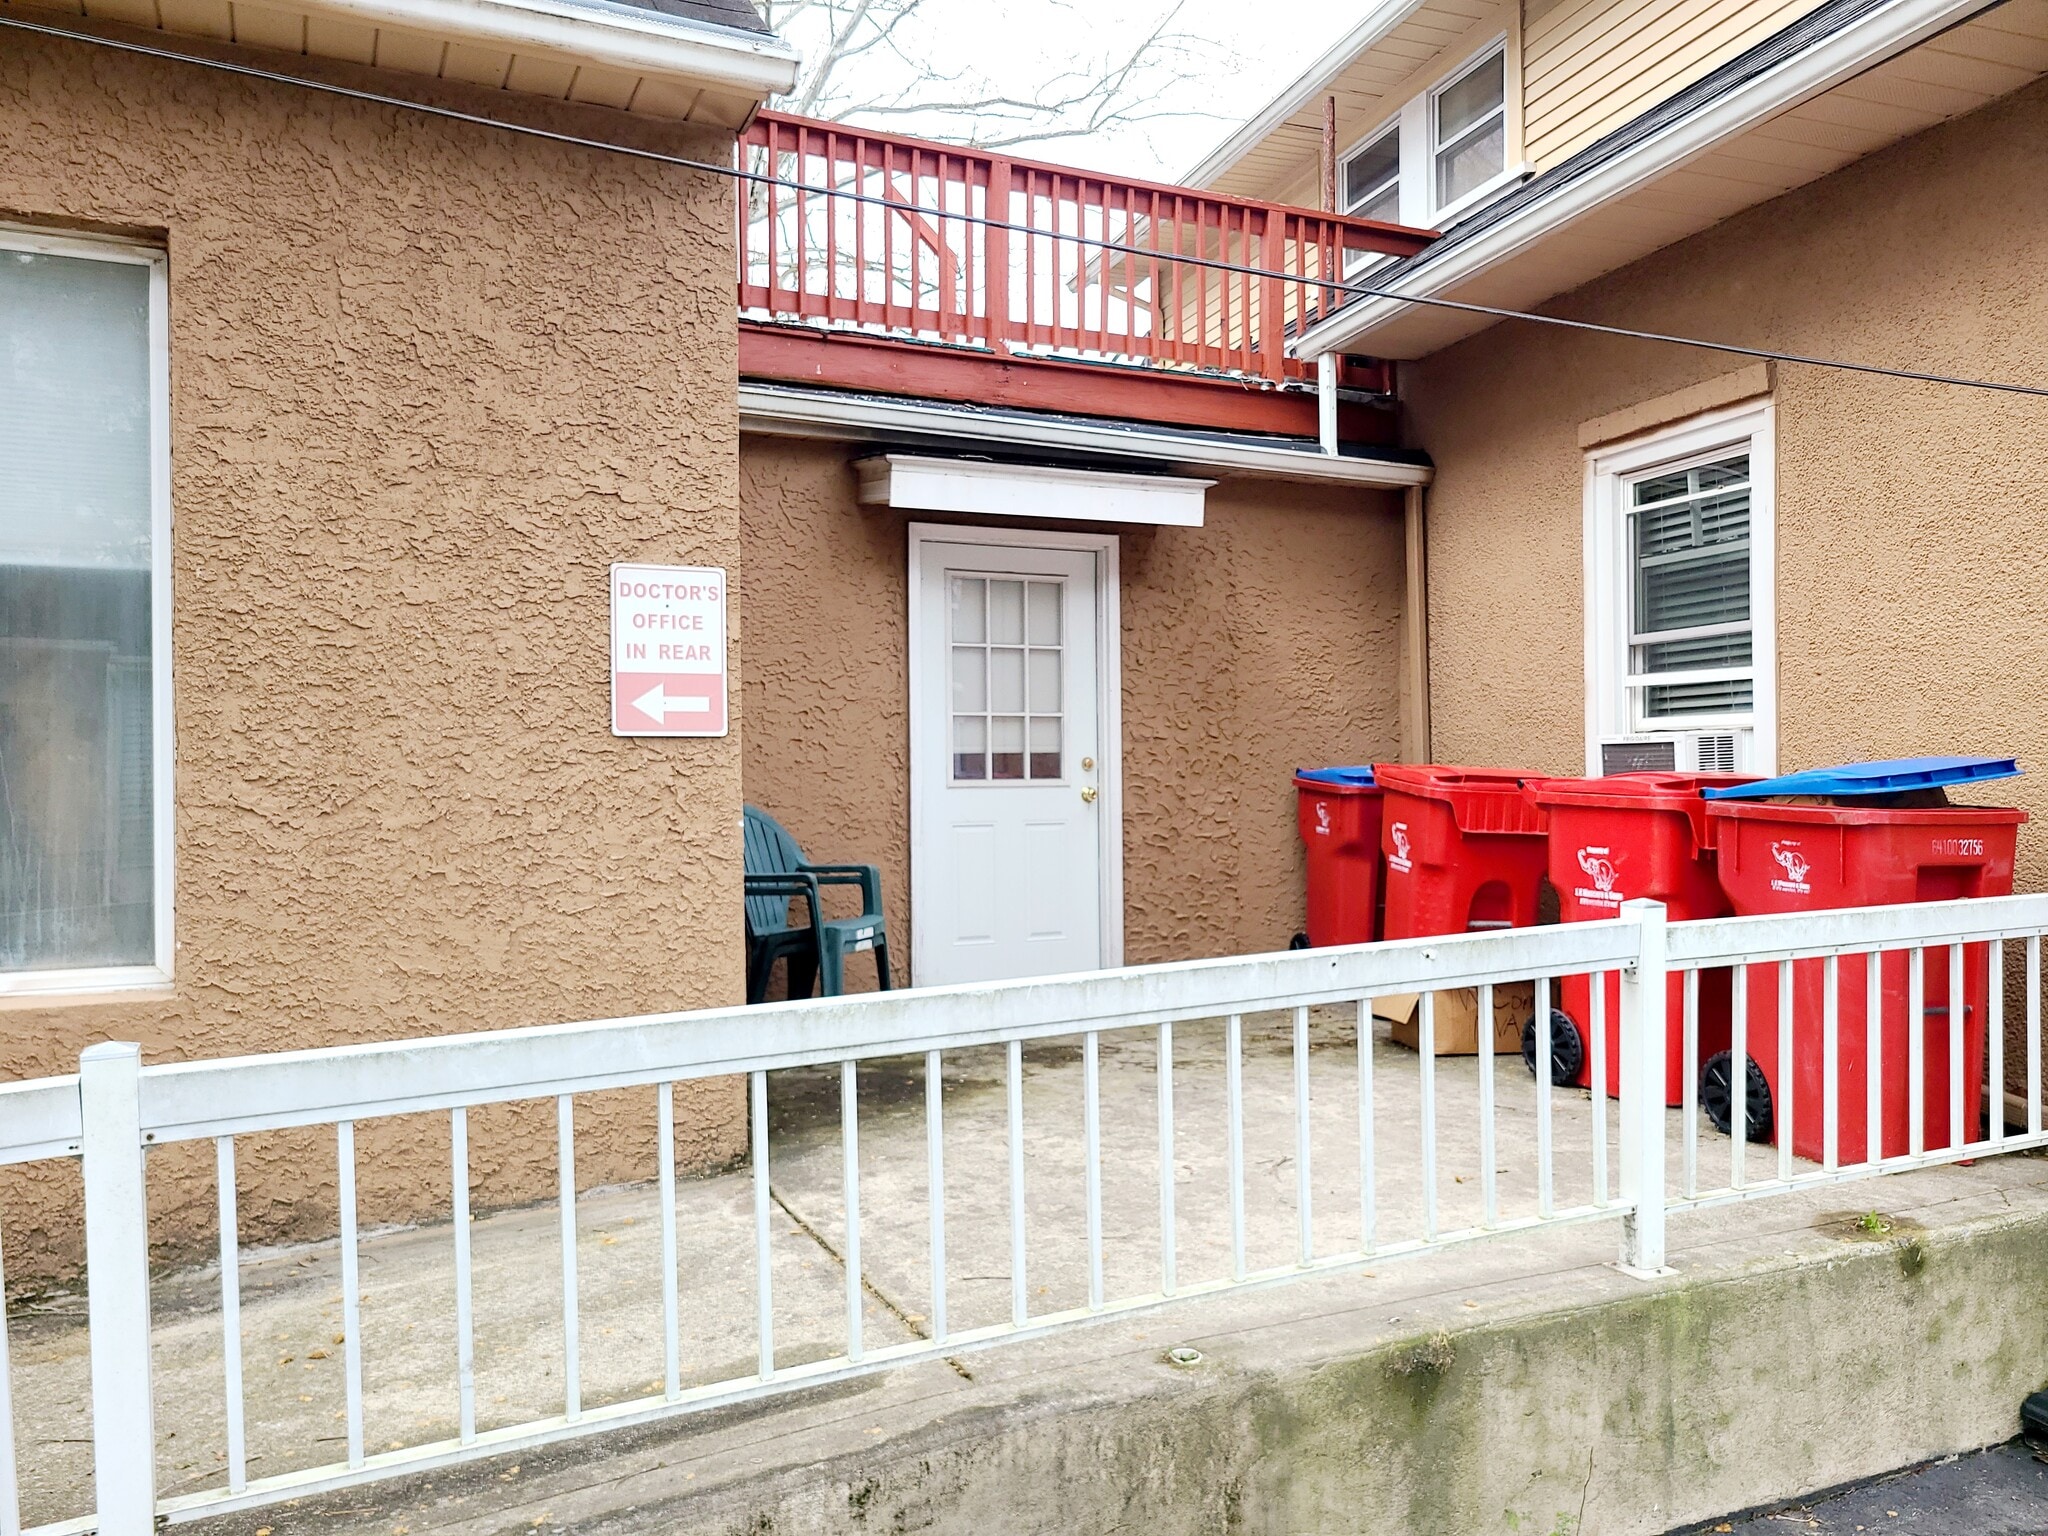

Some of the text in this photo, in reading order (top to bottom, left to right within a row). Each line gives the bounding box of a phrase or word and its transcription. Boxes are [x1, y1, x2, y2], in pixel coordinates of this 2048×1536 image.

[620, 582, 719, 602] DOCTOR'S
[632, 613, 704, 631] OFFICE
[626, 643, 712, 661] IN REAR
